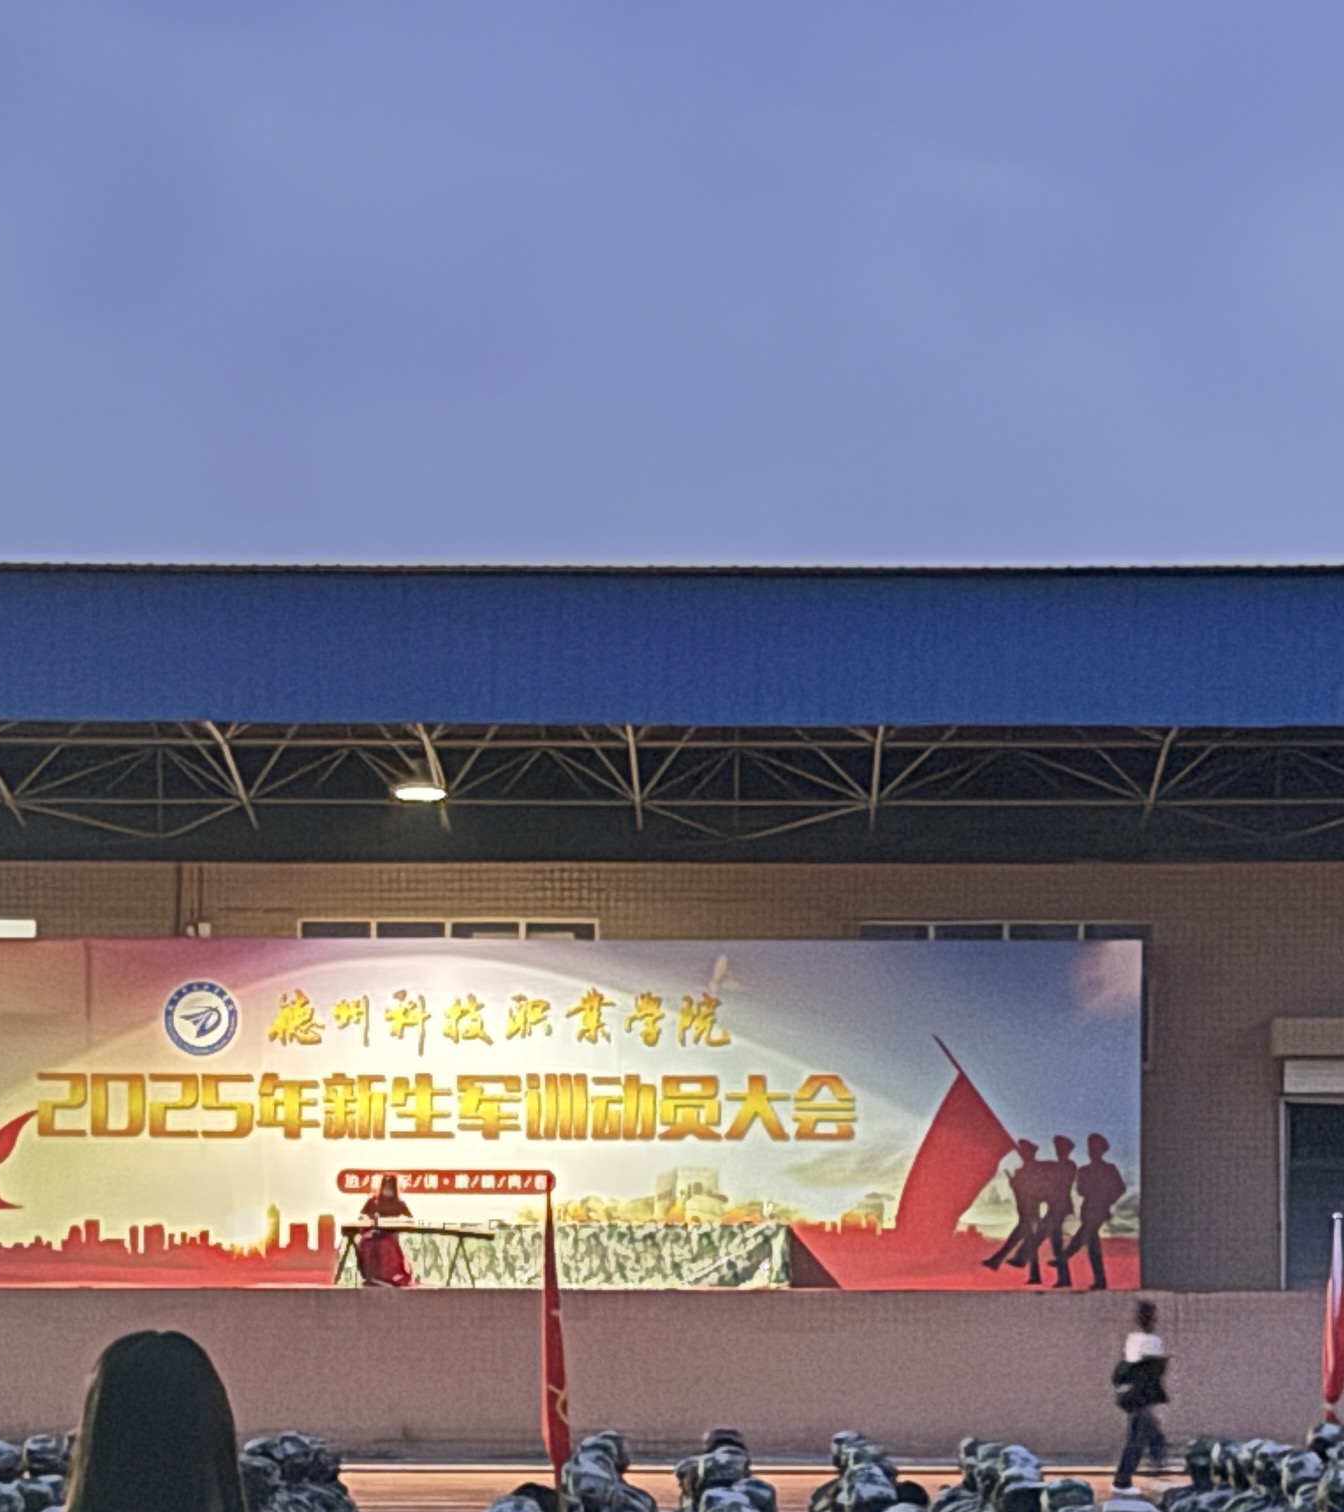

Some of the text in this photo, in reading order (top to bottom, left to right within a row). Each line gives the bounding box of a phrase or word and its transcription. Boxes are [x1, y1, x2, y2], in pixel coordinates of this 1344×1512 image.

[36, 1072, 856, 1141] 2025年新生军训动员大会
